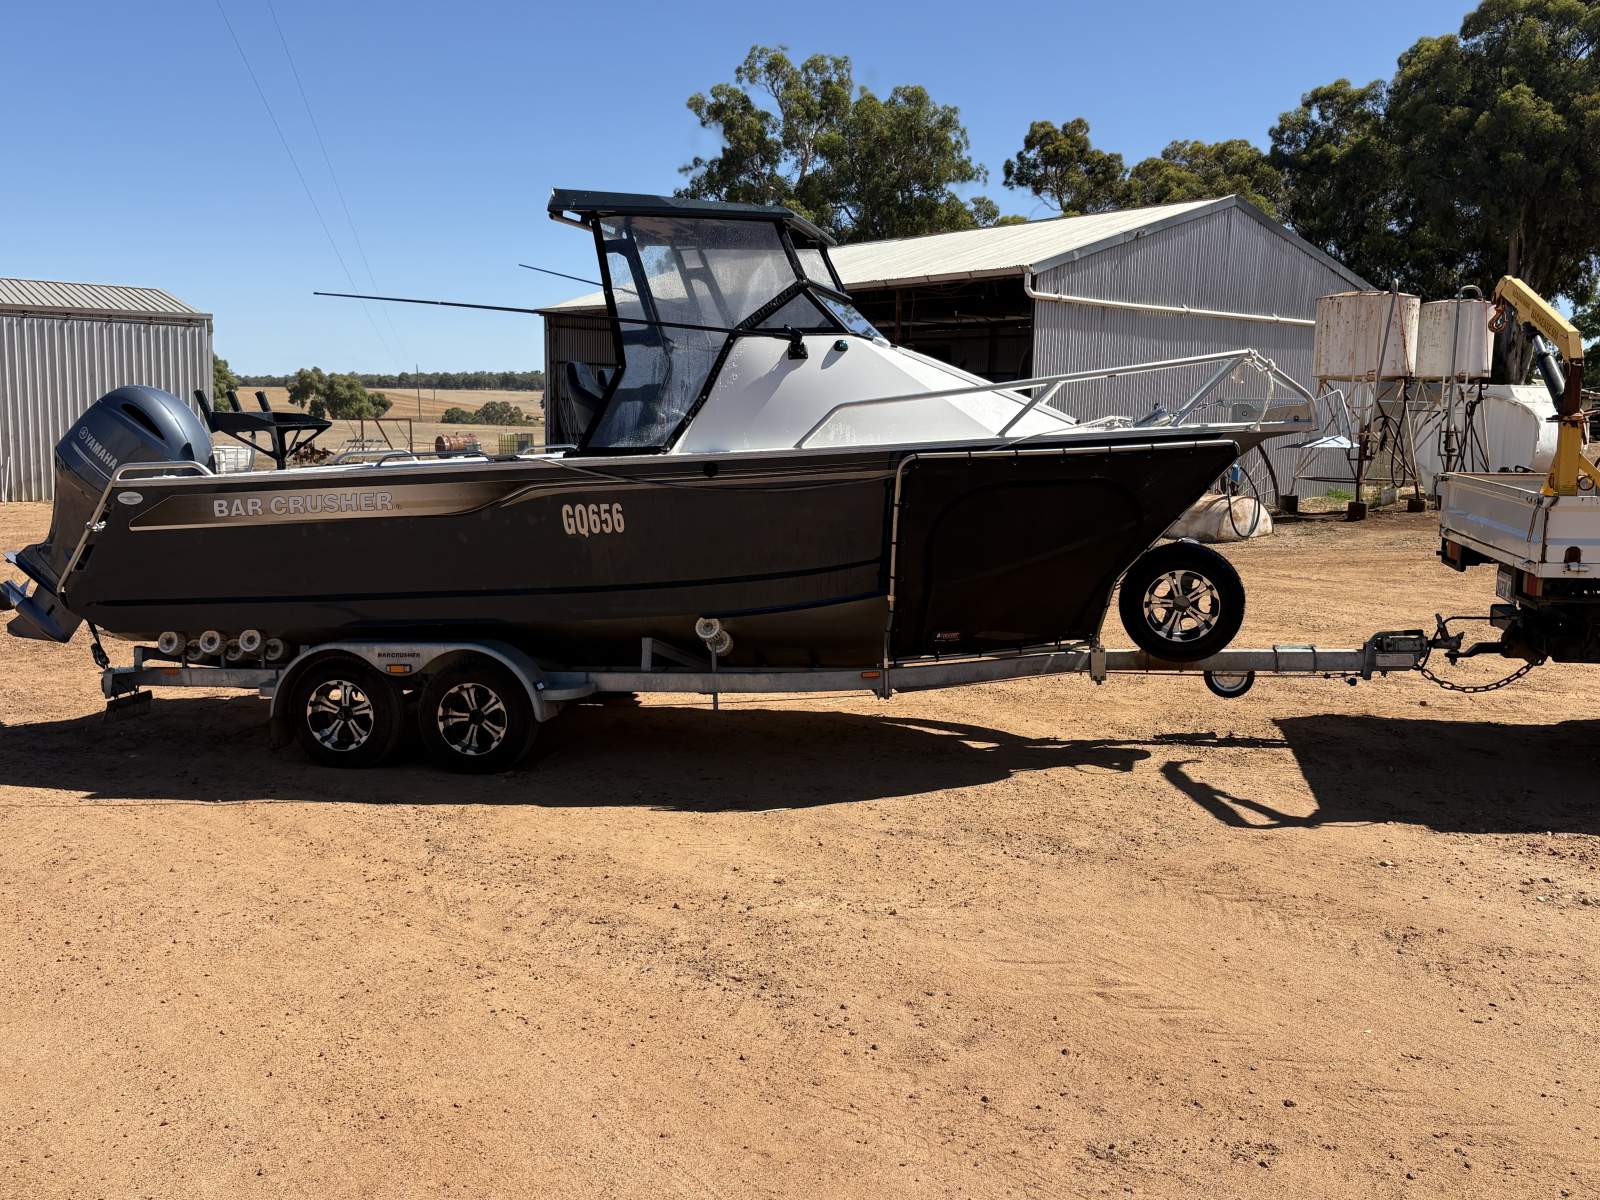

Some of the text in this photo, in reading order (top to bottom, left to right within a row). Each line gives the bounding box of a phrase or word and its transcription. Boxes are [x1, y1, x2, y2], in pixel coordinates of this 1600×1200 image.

[84, 433, 118, 470] YAMAHA
[213, 491, 393, 517] BAR CRUSHER
[562, 502, 625, 538] GQ656
